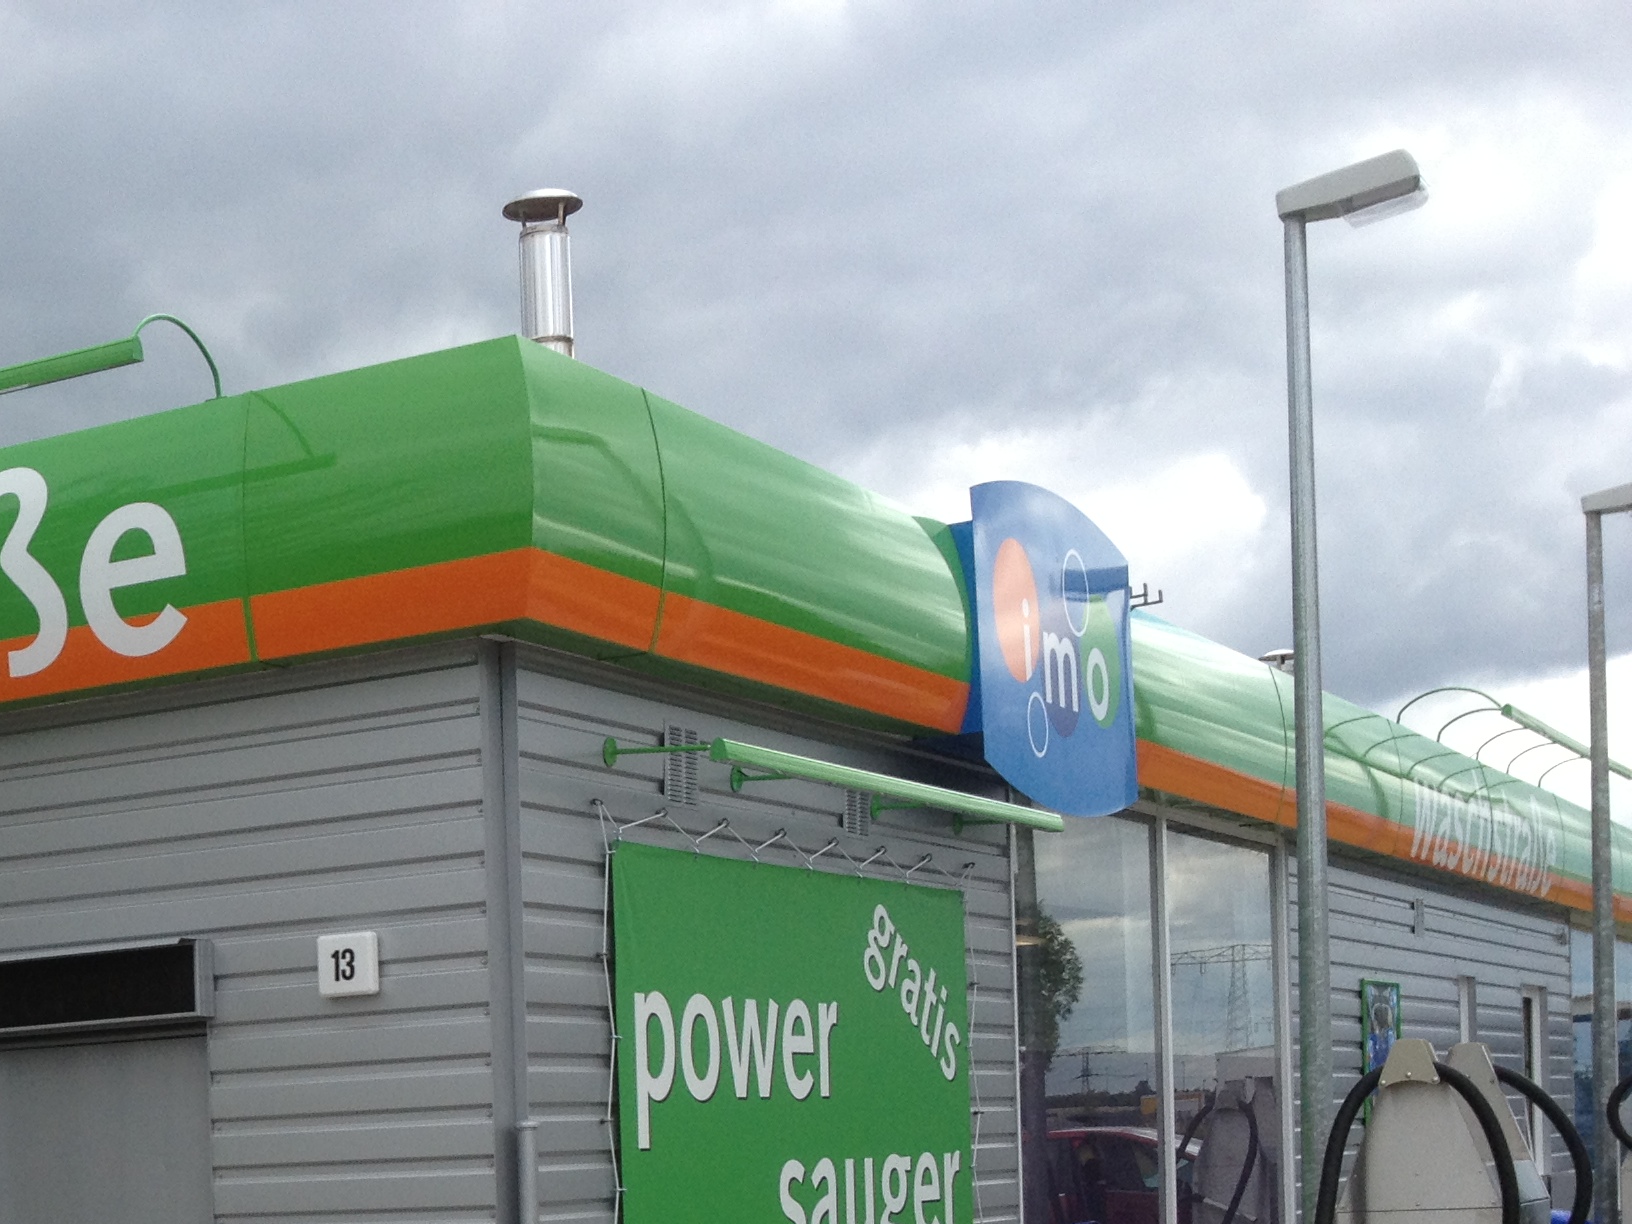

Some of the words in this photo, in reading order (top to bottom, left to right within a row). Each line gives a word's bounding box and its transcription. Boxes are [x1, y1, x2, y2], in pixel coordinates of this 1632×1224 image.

[1021, 597, 1110, 722] imo
[330, 948, 356, 982] 13
[862, 903, 961, 1082] gratis
[632, 989, 839, 1150] power
